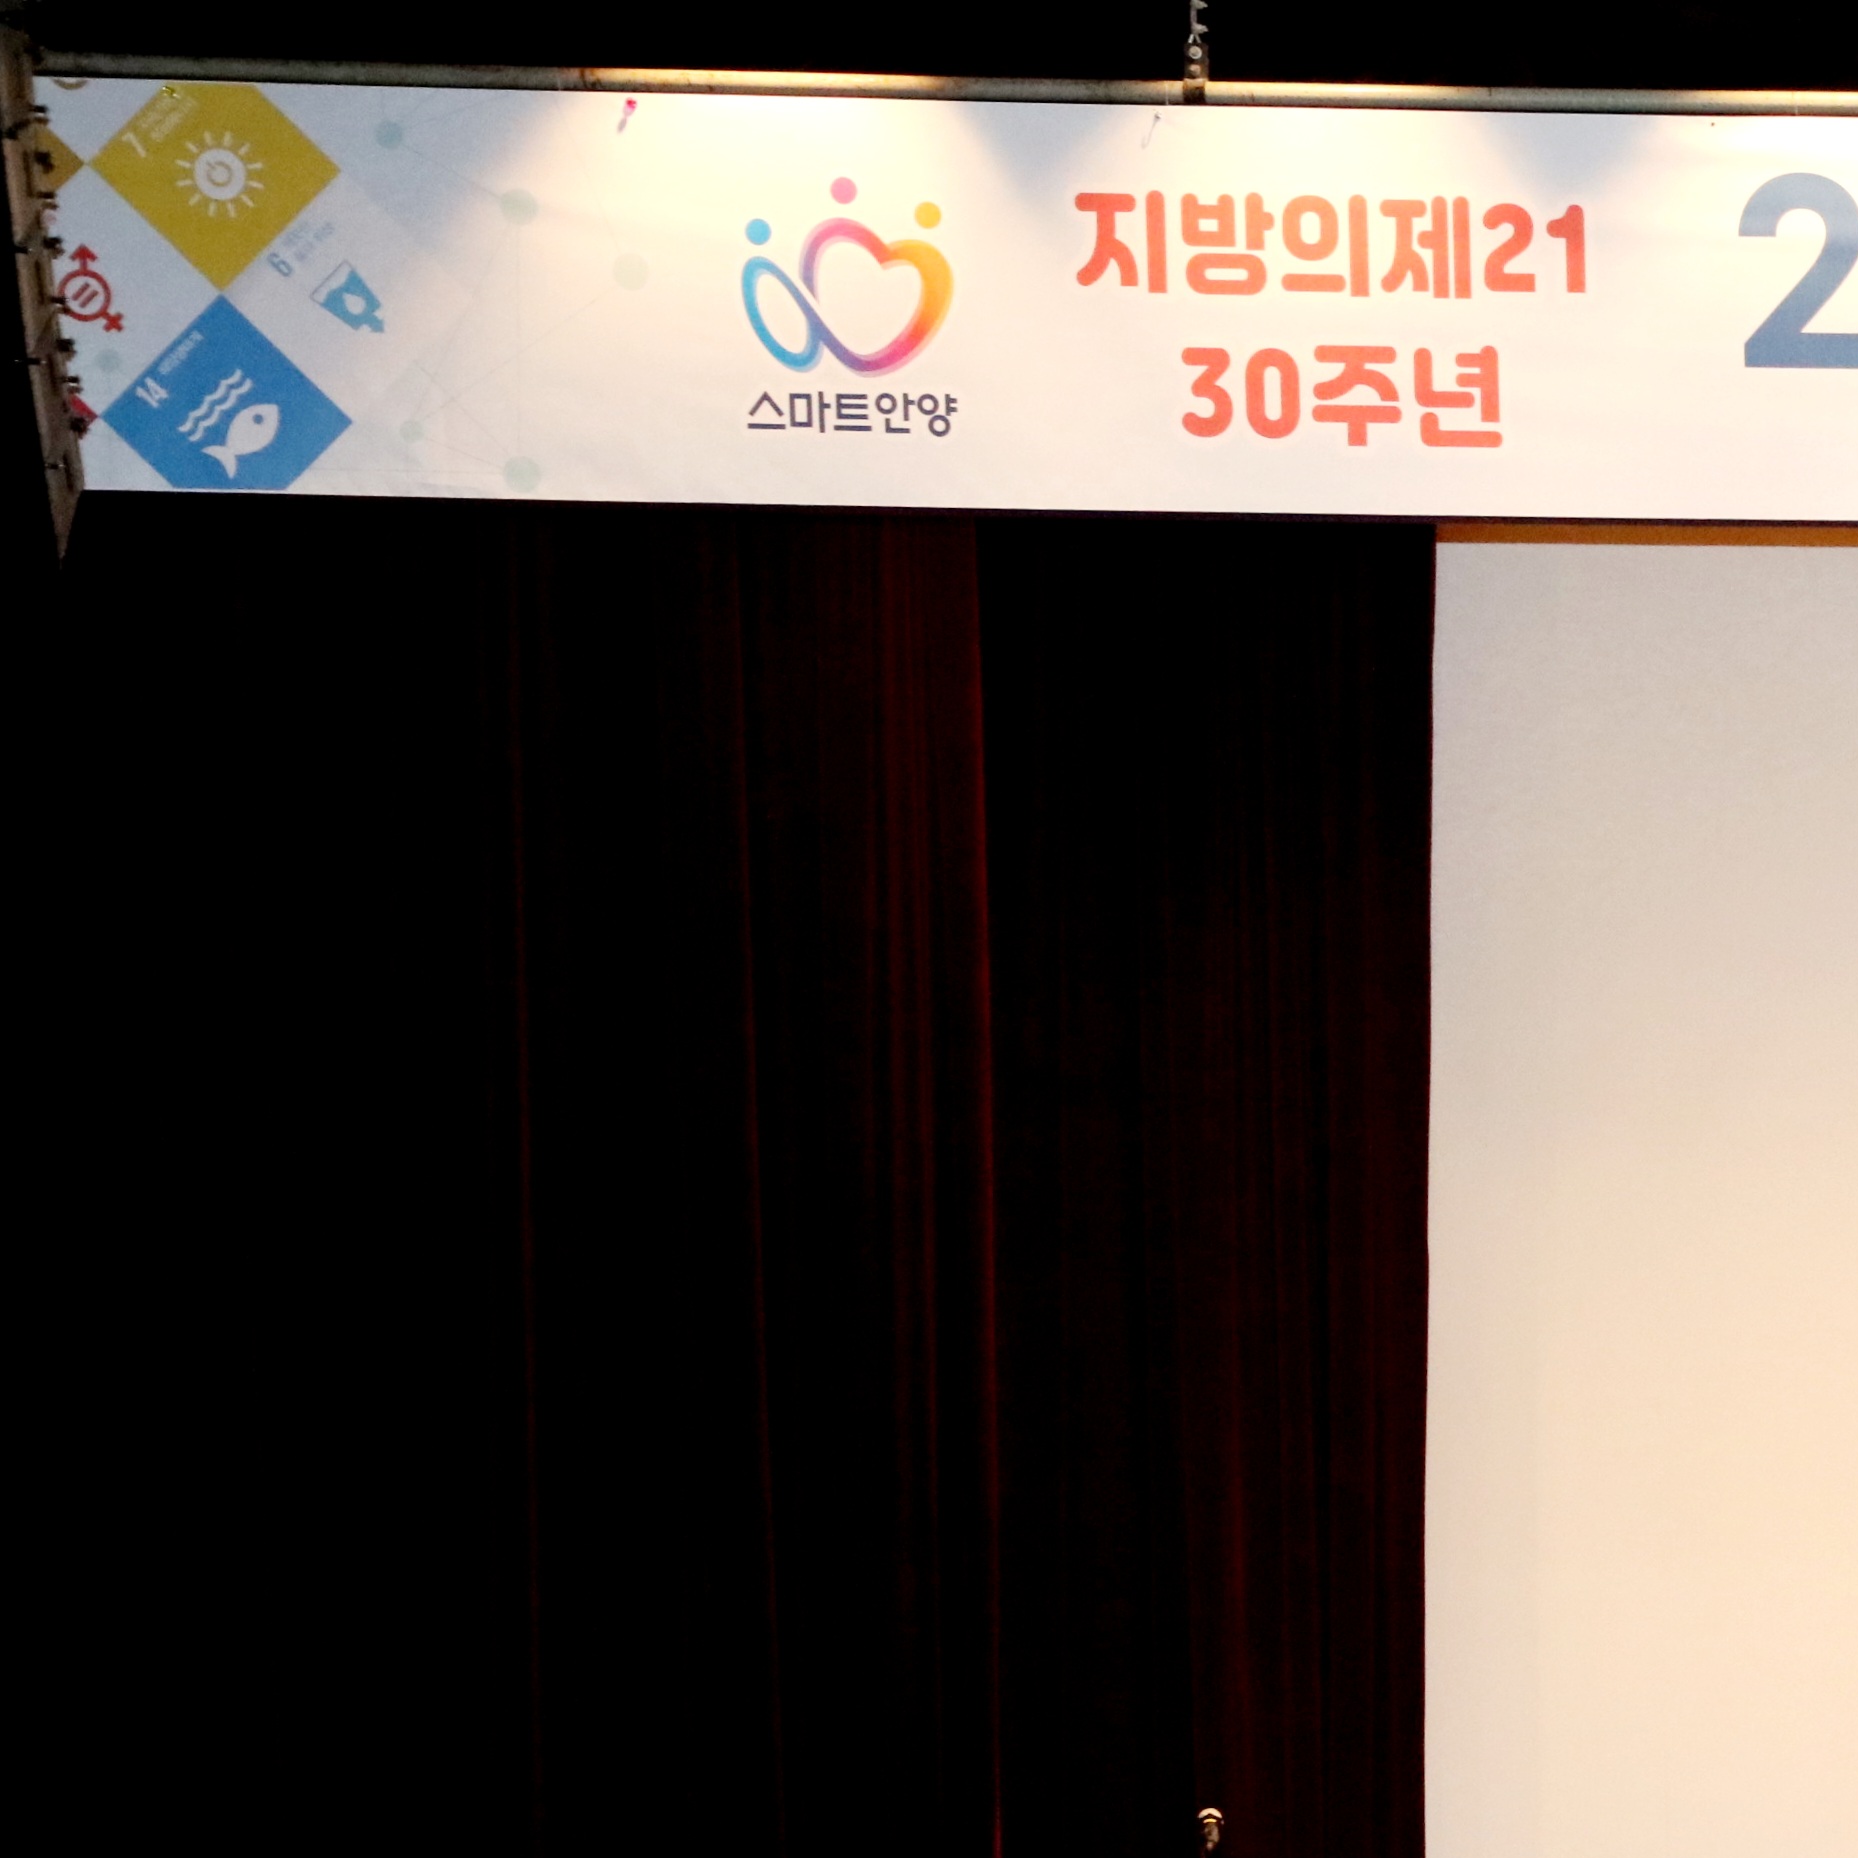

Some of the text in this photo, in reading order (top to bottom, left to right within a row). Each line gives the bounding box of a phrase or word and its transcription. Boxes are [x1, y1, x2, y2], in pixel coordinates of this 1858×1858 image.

[1074, 189, 1587, 299] 지방의제21
[135, 376, 170, 410] 14
[747, 391, 958, 438] 스마트안양
[1181, 344, 1503, 449] 30주년
